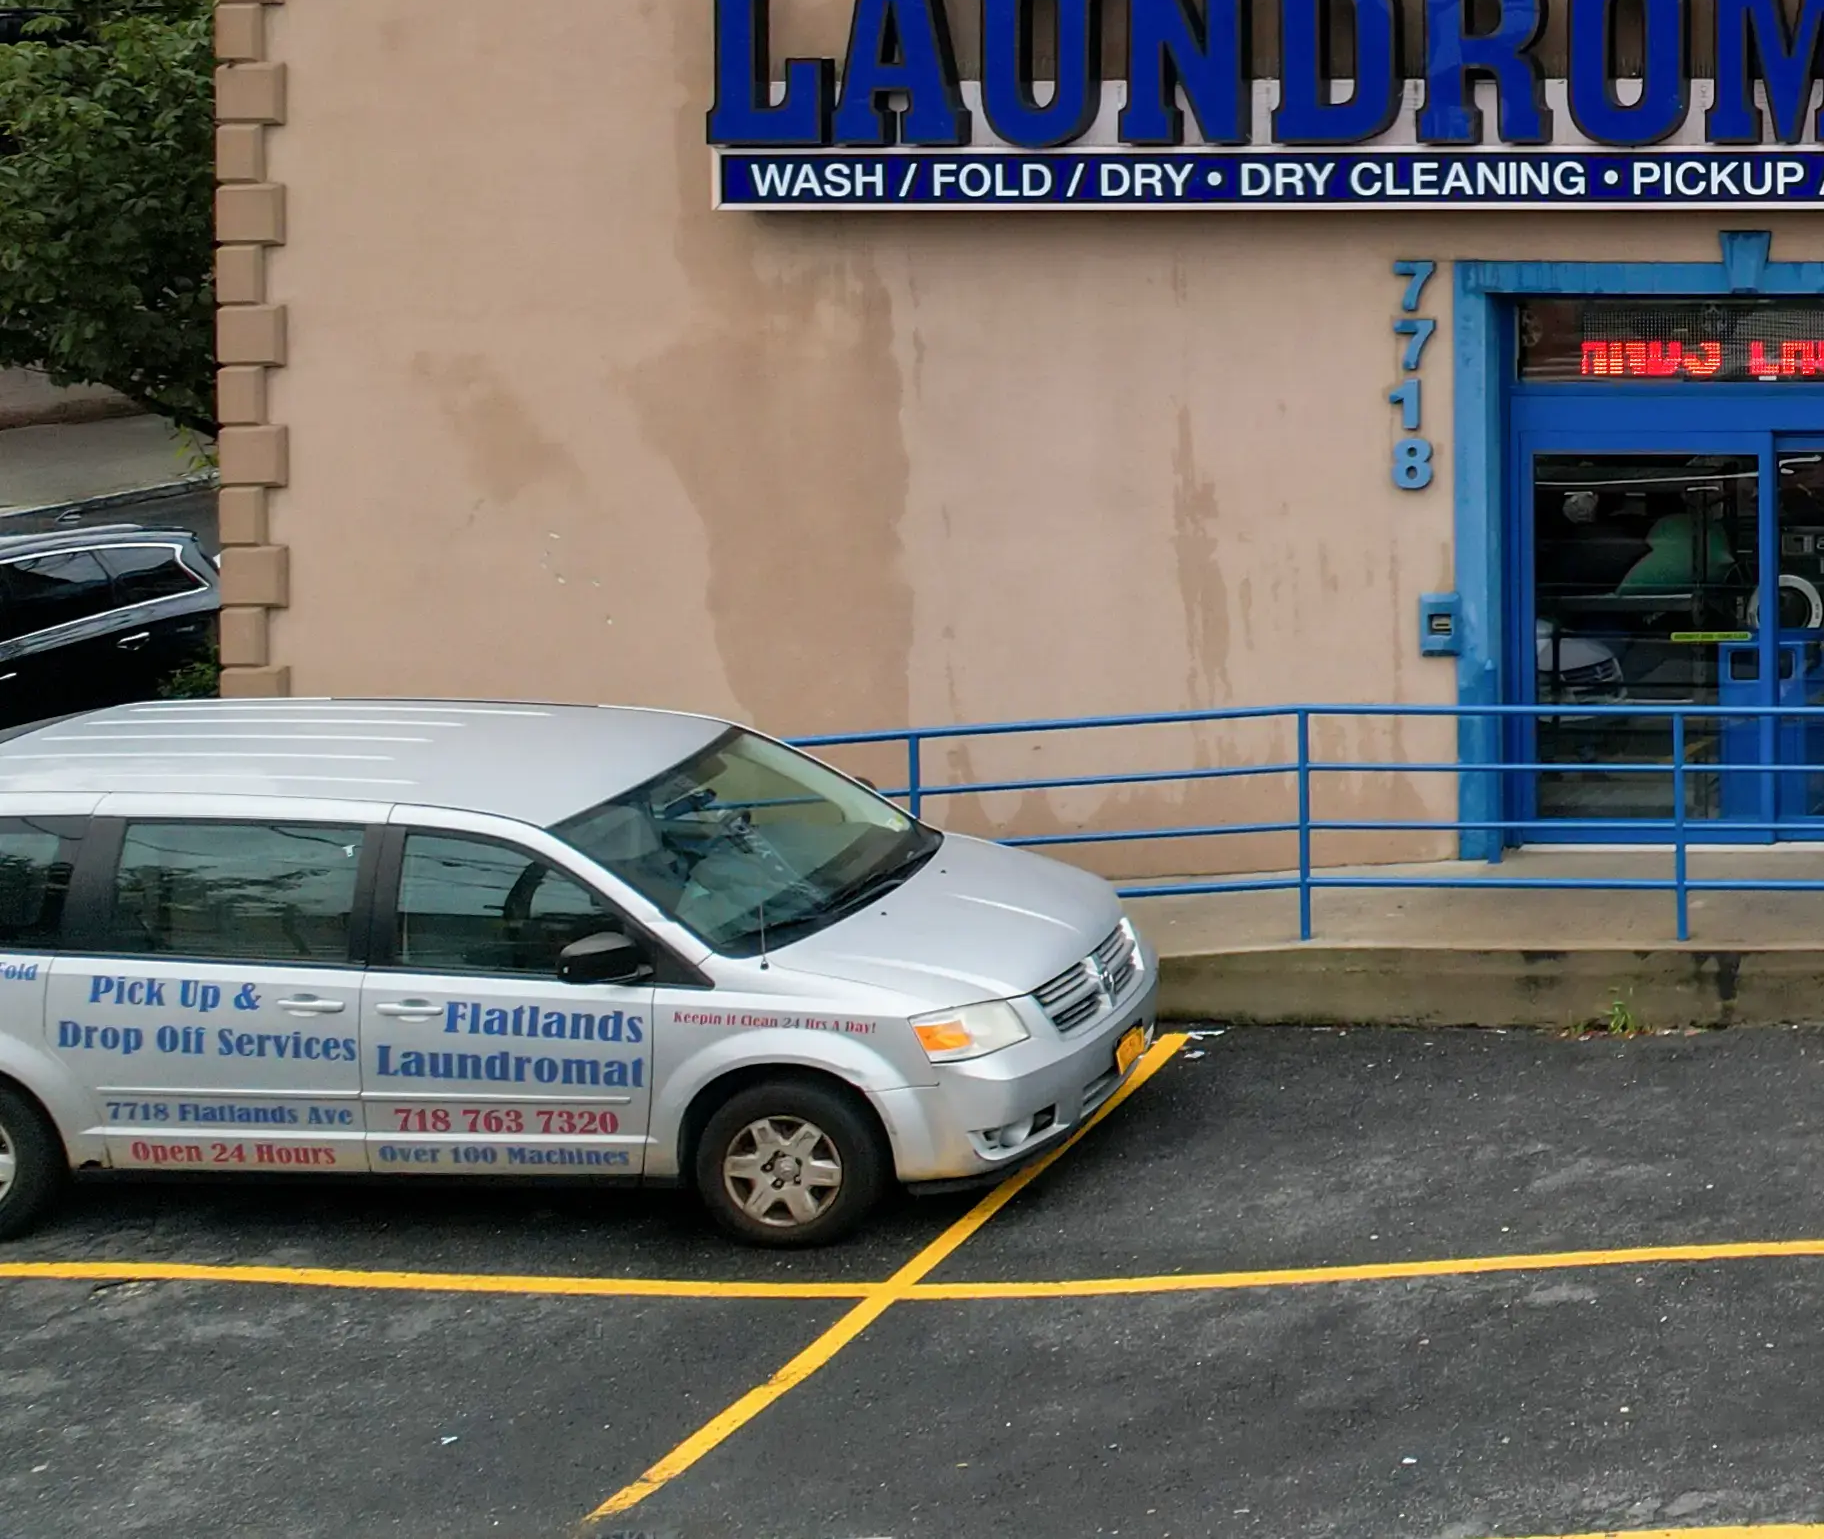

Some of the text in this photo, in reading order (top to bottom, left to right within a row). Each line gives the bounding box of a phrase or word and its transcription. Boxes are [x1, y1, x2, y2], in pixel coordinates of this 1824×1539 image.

[751, 164, 885, 197] WASH
[933, 163, 1053, 197] FOLD
[1101, 163, 1194, 197] DRY
[1240, 163, 1336, 196] DRY
[1349, 162, 1587, 196] CLEANING
[1632, 162, 1805, 196] PICKUP
[1391, 262, 1436, 490] 7718
[0, 963, 39, 982] old
[89, 975, 262, 1012] Pick Up &
[444, 1001, 645, 1043] Flatlands
[673, 1011, 722, 1026] Keepin
[740, 1014, 778, 1028] Clean
[781, 1016, 800, 1029] 24
[805, 1018, 828, 1031] Hrs
[832, 1020, 840, 1032] A
[844, 1021, 877, 1034] Day!
[58, 1020, 357, 1062] Drop Off Services
[376, 1044, 645, 1088] Laundromat
[106, 1102, 354, 1126] 7718 Flatlands Ave
[394, 1108, 619, 1135] 718 763 7320
[131, 1141, 338, 1165] Open 24 Hours
[378, 1145, 629, 1166] Over 100 Machines
